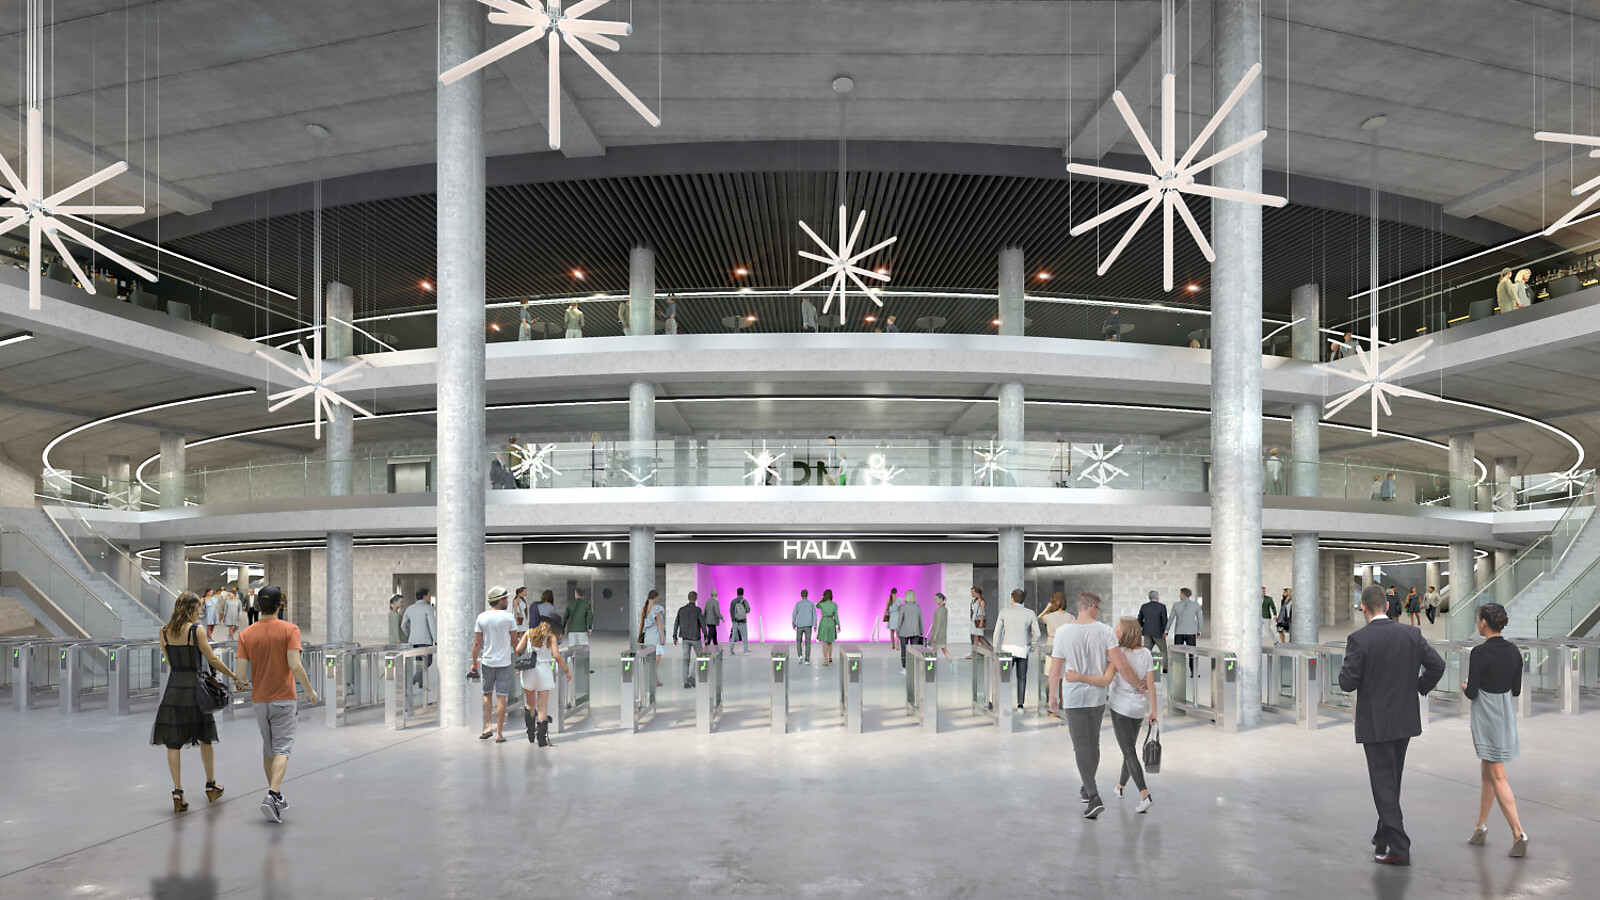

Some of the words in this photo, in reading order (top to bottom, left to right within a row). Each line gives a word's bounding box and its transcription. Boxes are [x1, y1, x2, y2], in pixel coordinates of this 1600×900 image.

[582, 541, 613, 560] A1
[782, 540, 856, 560] HALA
[1032, 541, 1064, 562] A2
